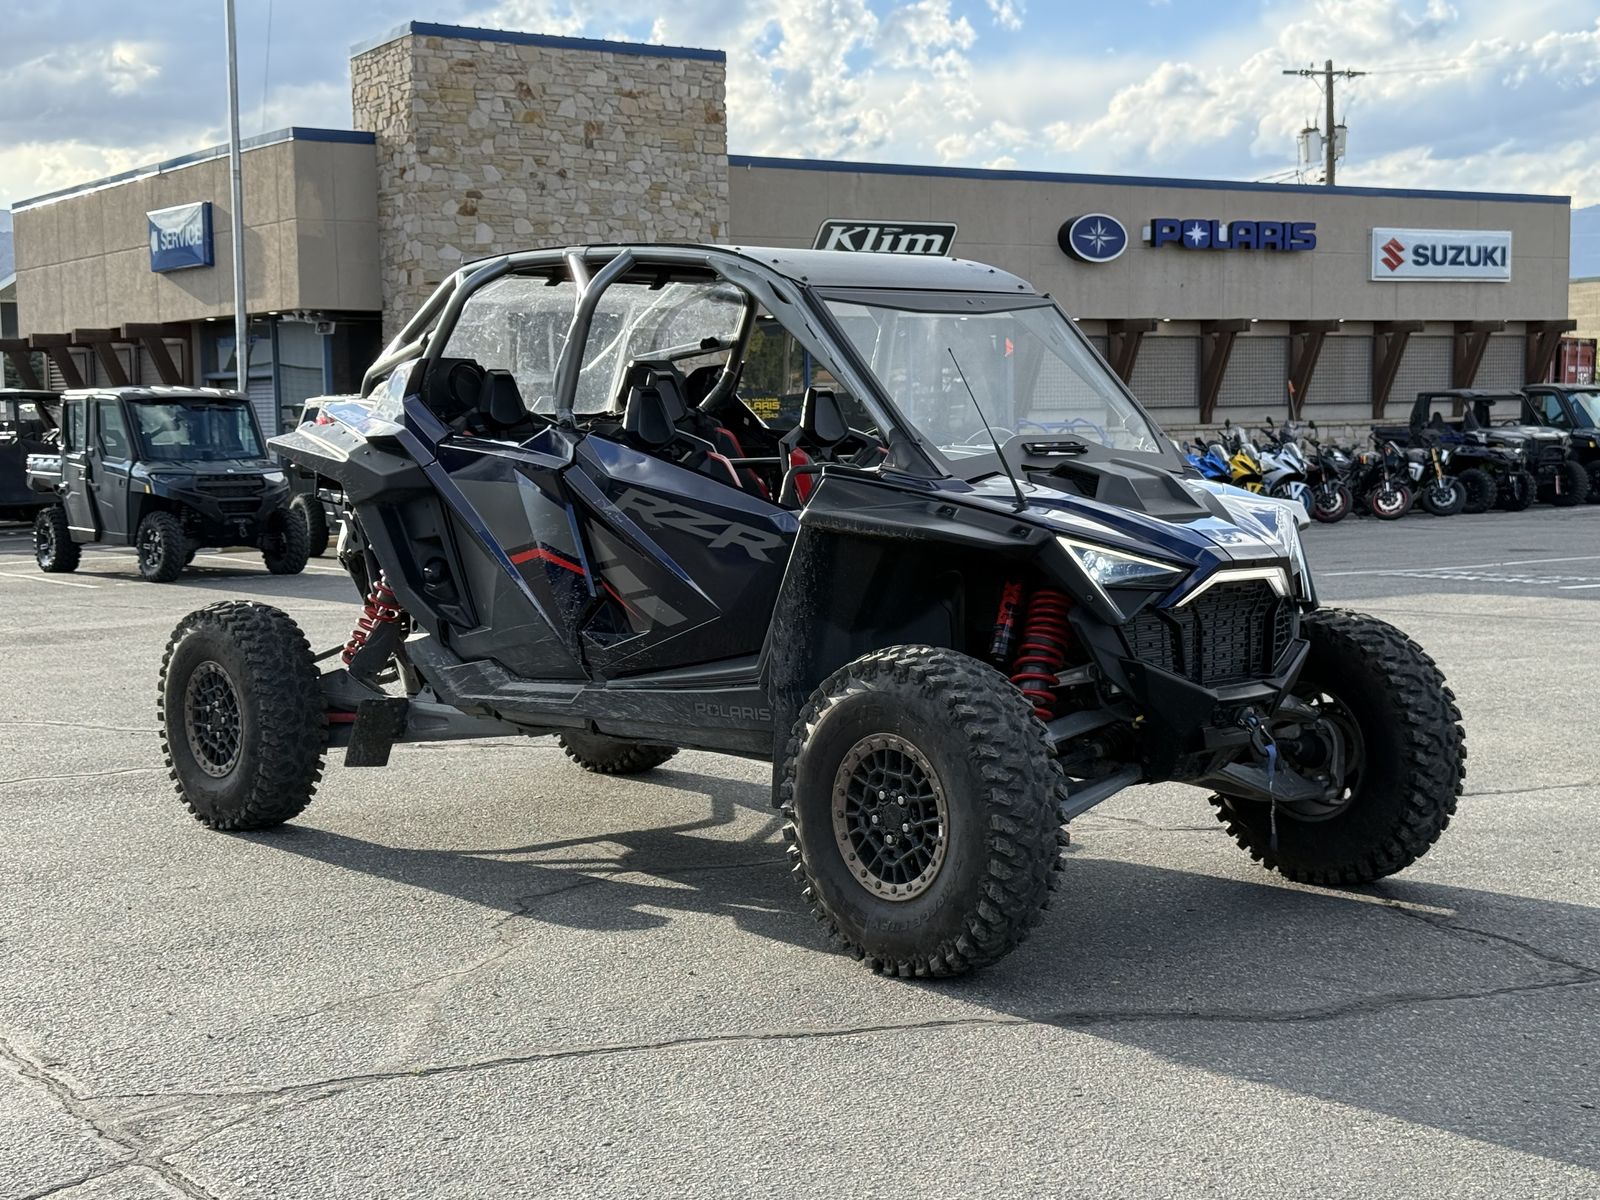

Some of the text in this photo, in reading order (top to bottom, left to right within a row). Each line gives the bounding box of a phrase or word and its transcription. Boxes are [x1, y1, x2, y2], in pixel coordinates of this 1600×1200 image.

[160, 224, 203, 250] SERVICE
[1150, 218, 1317, 251] POLARIS
[1412, 244, 1507, 267] SUZUKI
[743, 401, 781, 410] LARIS
[613, 487, 788, 564] RZR
[694, 702, 771, 721] POLARIS
